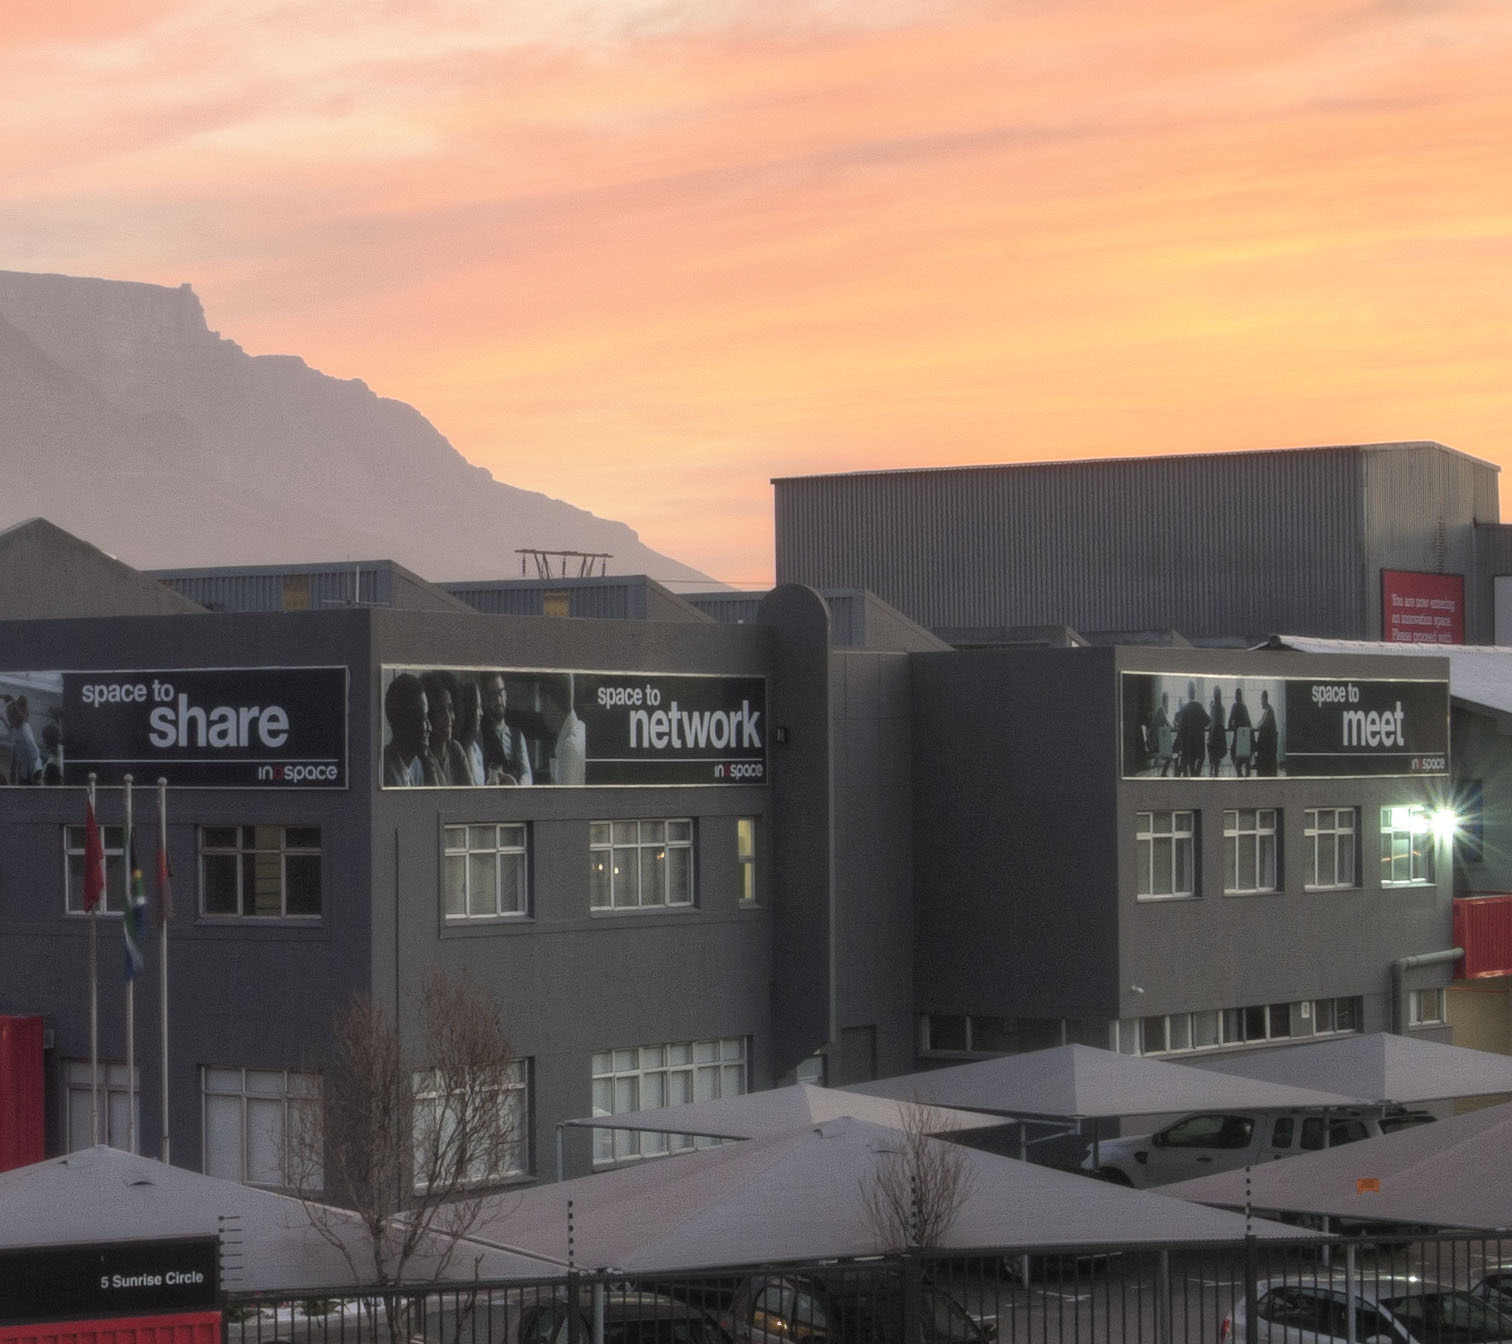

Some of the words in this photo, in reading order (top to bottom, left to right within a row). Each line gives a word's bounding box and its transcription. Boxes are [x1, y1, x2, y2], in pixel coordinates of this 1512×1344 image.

[82, 684, 147, 708] space
[152, 679, 175, 702] to
[597, 687, 643, 709] space
[645, 684, 661, 706] to
[1312, 685, 1346, 708] space
[1347, 682, 1360, 703] to
[149, 693, 290, 748] share
[629, 699, 762, 749] network
[1342, 701, 1405, 747] meet
[258, 765, 338, 783] inospace
[100, 1275, 109, 1289] 5
[112, 1273, 163, 1288] Sunrise
[165, 1270, 204, 1285] Circle
